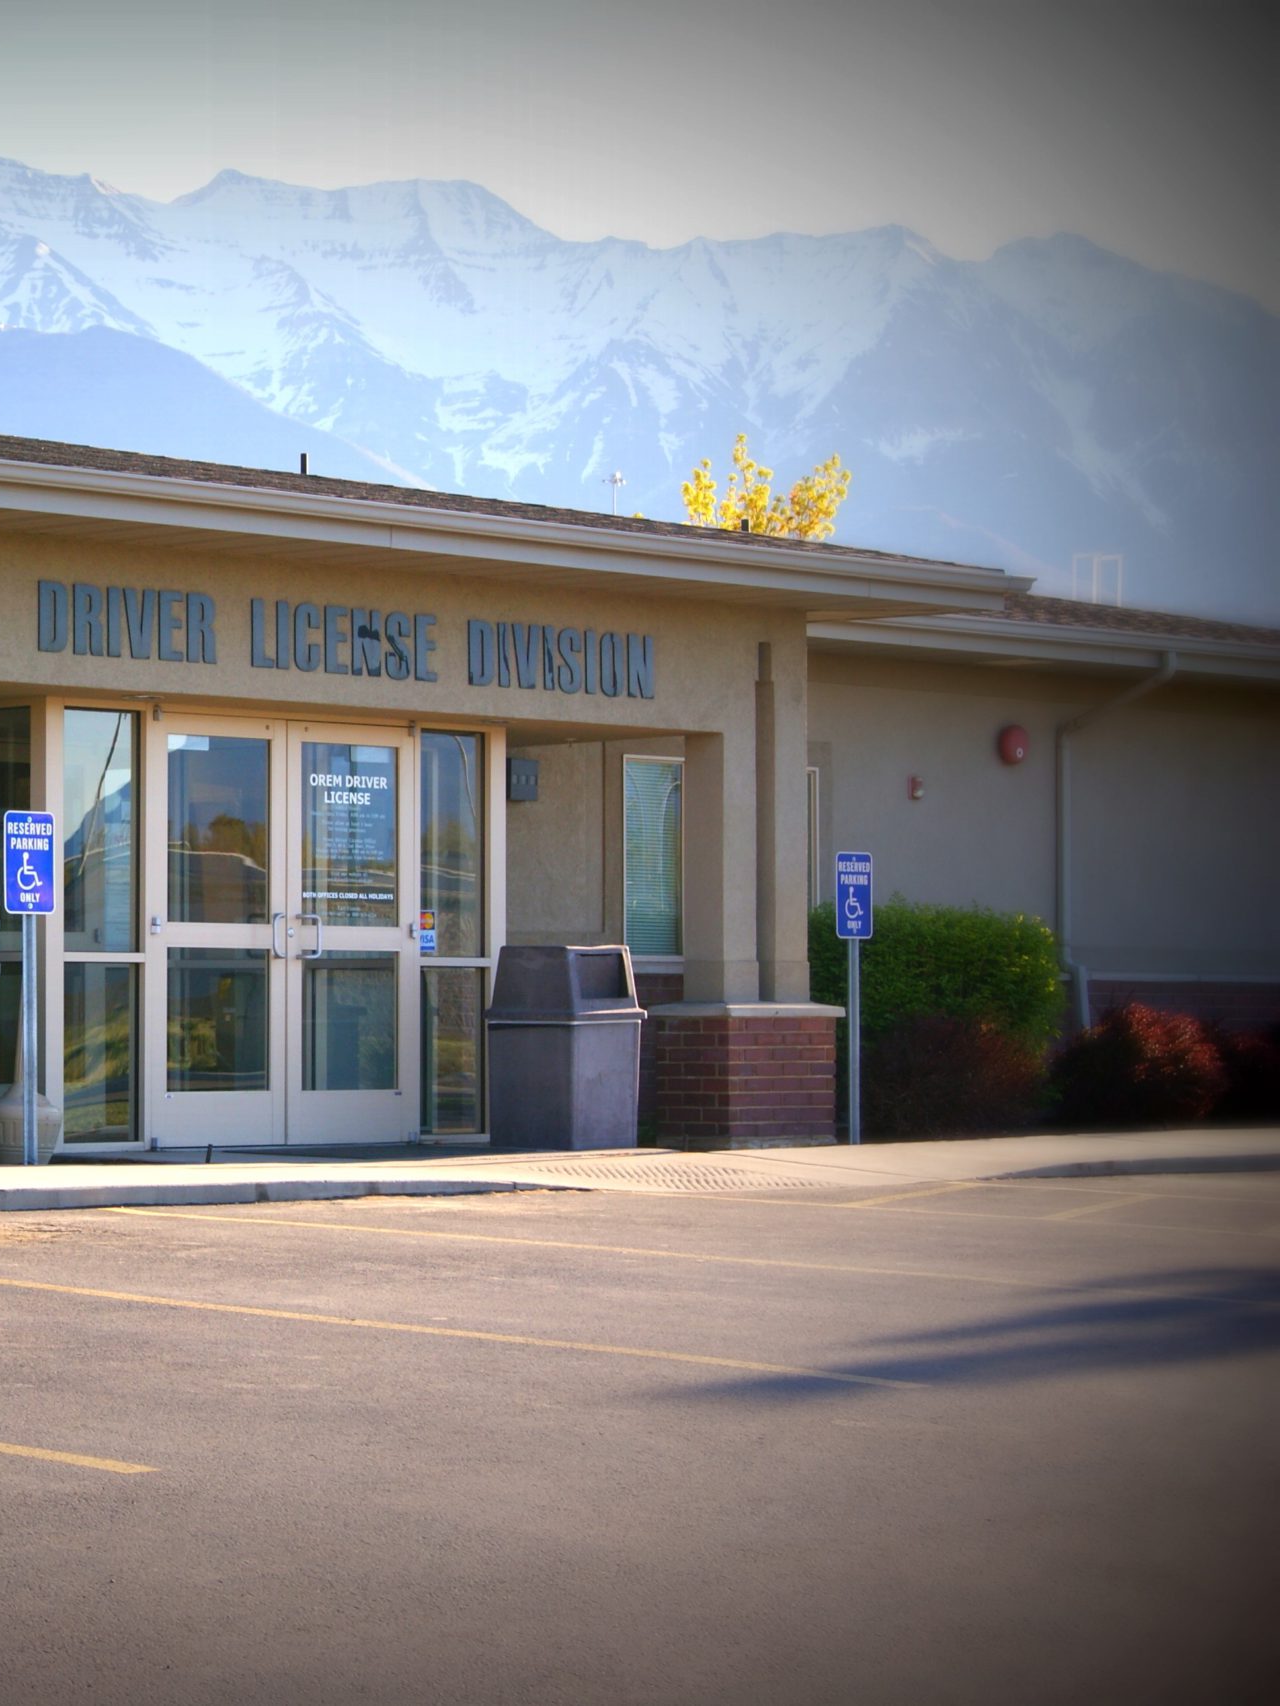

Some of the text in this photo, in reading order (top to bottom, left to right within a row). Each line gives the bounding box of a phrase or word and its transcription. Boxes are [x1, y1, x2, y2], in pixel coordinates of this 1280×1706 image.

[37, 579, 655, 699] DRIVER LICENSE DIVISION
[309, 773, 388, 789] OREM DRIVER
[324, 791, 371, 805] LICENSE
[7, 821, 52, 836] RESERVED
[10, 837, 49, 851] PARKING
[838, 861, 870, 873] RESERVED
[840, 874, 868, 886] PARKING
[20, 892, 40, 903] ONLY
[847, 920, 862, 929] ONLY
